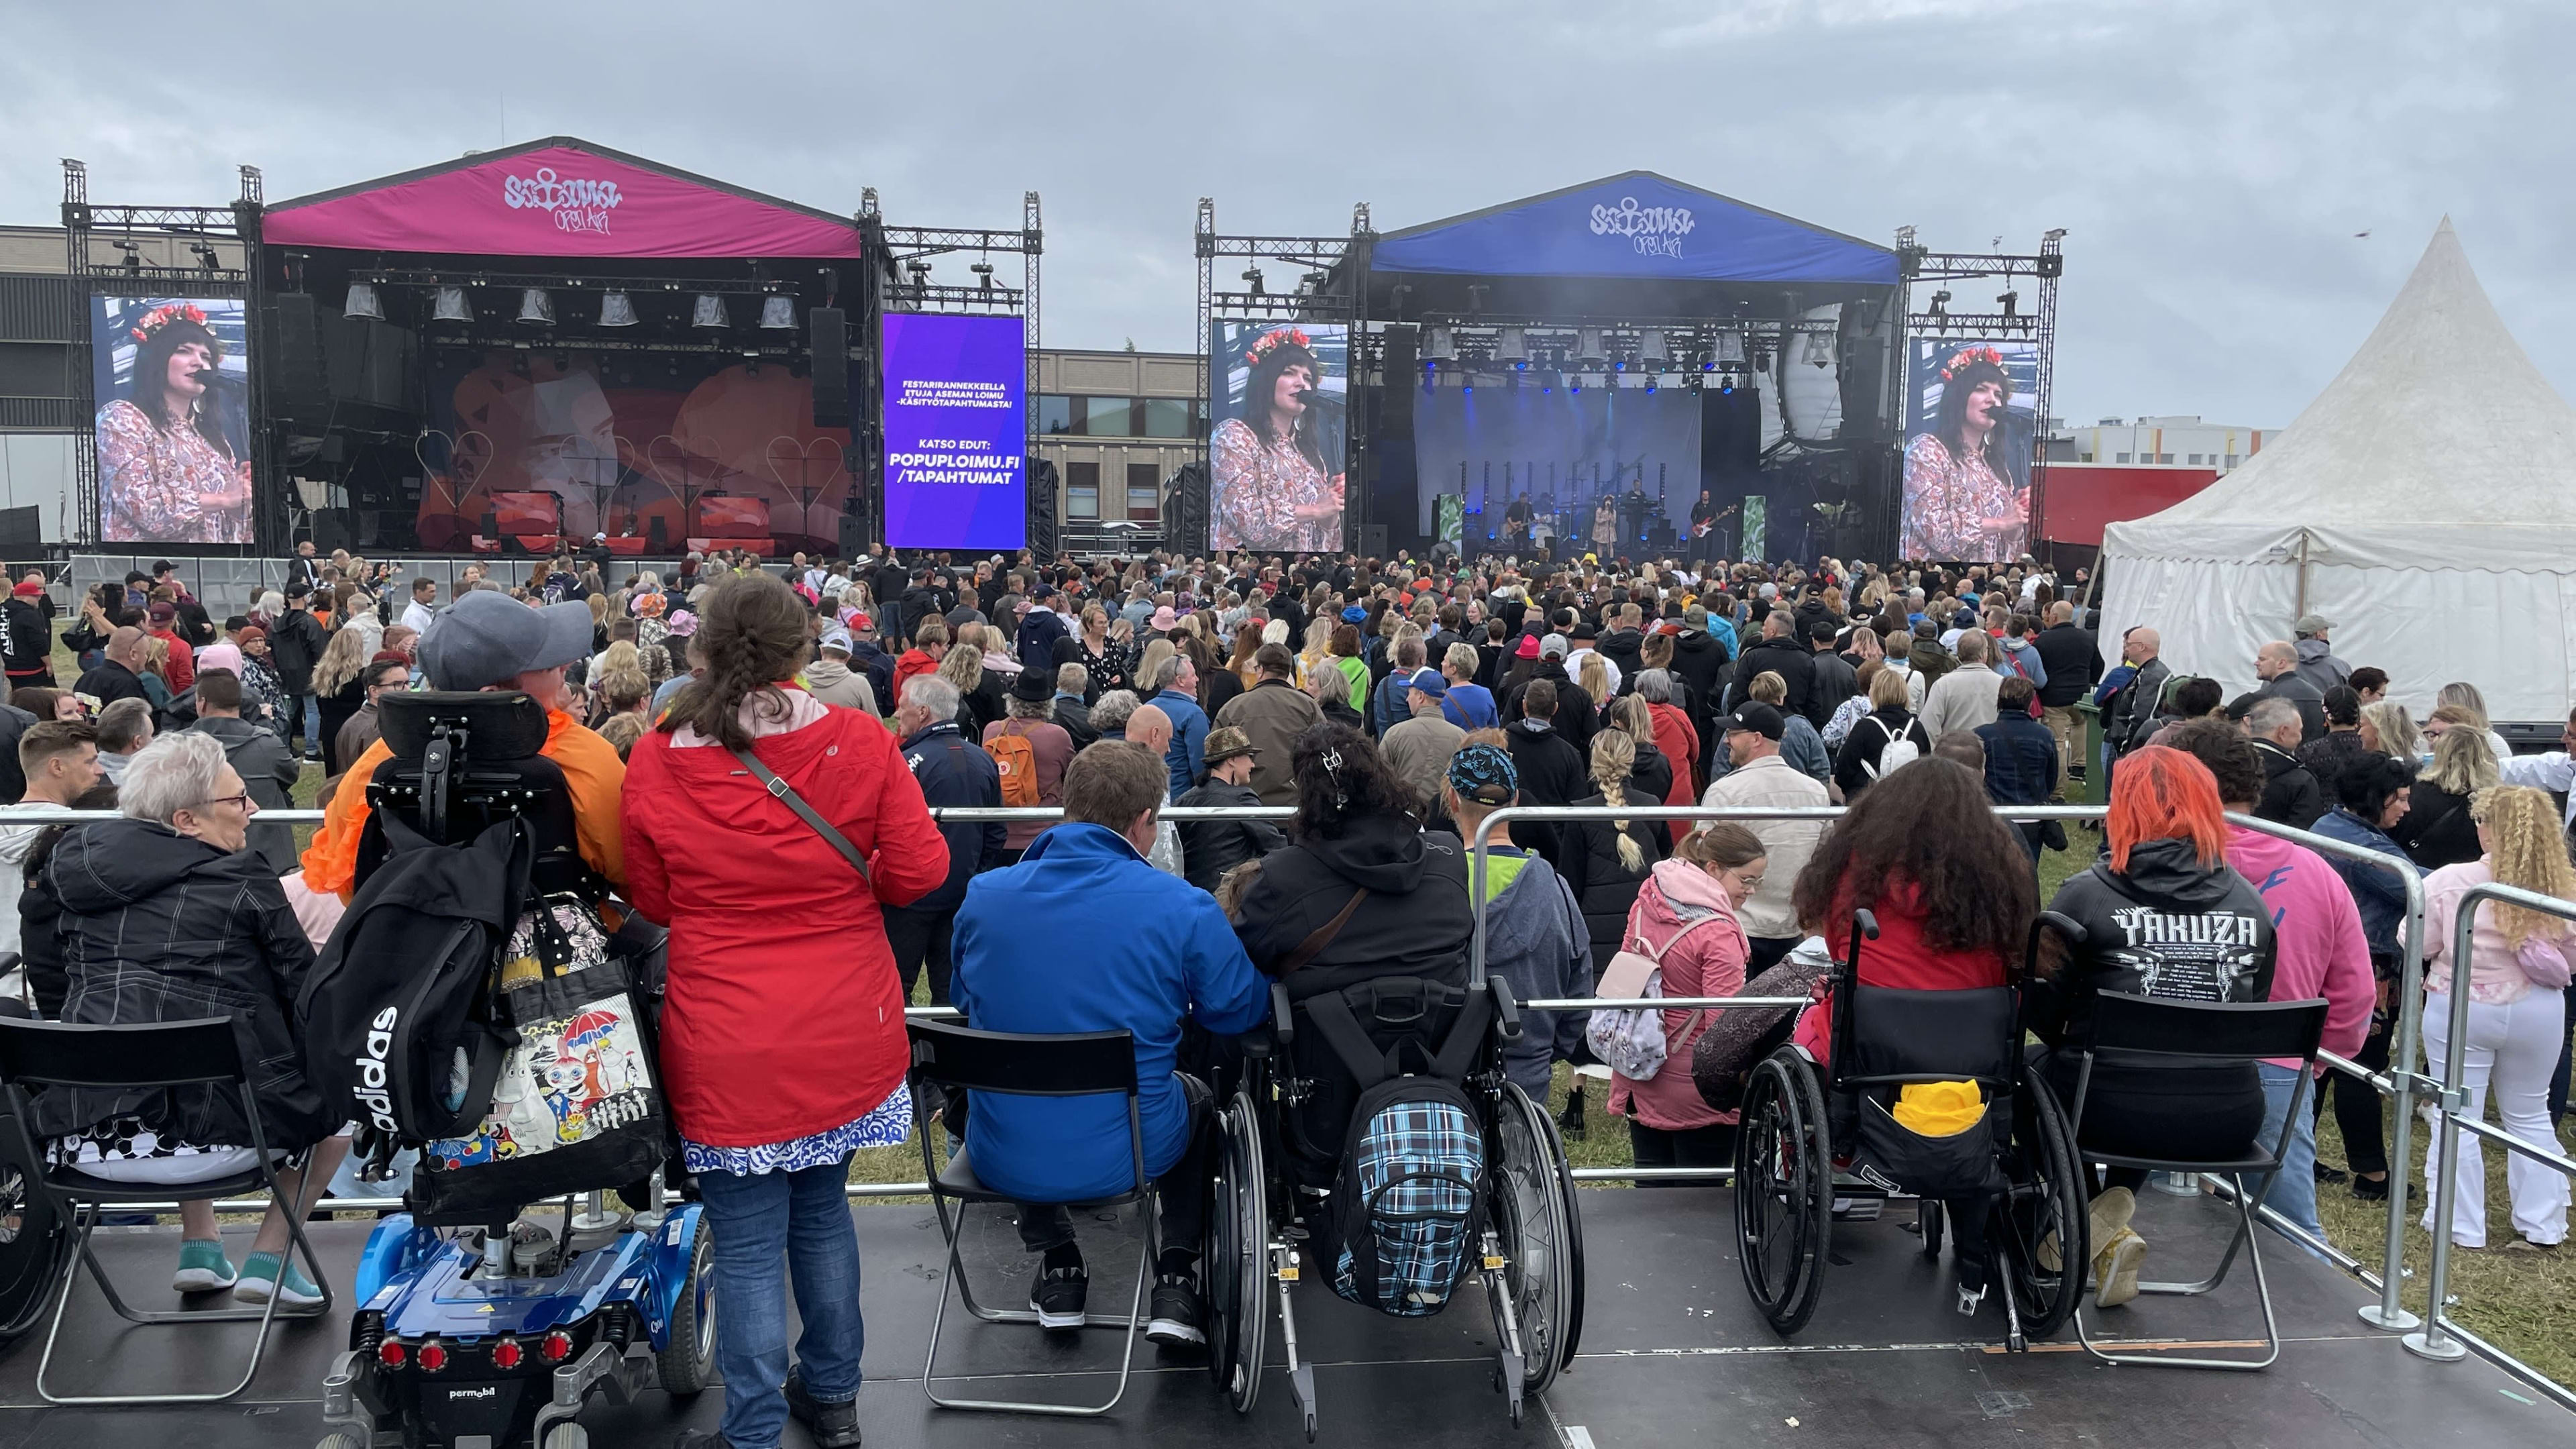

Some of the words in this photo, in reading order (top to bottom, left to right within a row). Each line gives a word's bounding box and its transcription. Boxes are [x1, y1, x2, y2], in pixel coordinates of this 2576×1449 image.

[902, 380, 1006, 391] FESTARIRANNEKKEELLA
[905, 389, 933, 398] ETUJA
[935, 390, 973, 398] ASEMAN
[896, 397, 1012, 408] -KÄSITYÖTAPAHTUMASTA!
[919, 439, 956, 449] KATSO
[959, 440, 991, 449] EDUT:
[890, 453, 1020, 469] POPUPLOIMU.FI
[897, 469, 1013, 484] /TAPAHTUMAT
[2110, 906, 2257, 947] YAKUZA
[353, 1006, 398, 1132] adidas
[651, 1318, 663, 1334] C300
[449, 1387, 495, 1399] permobil
